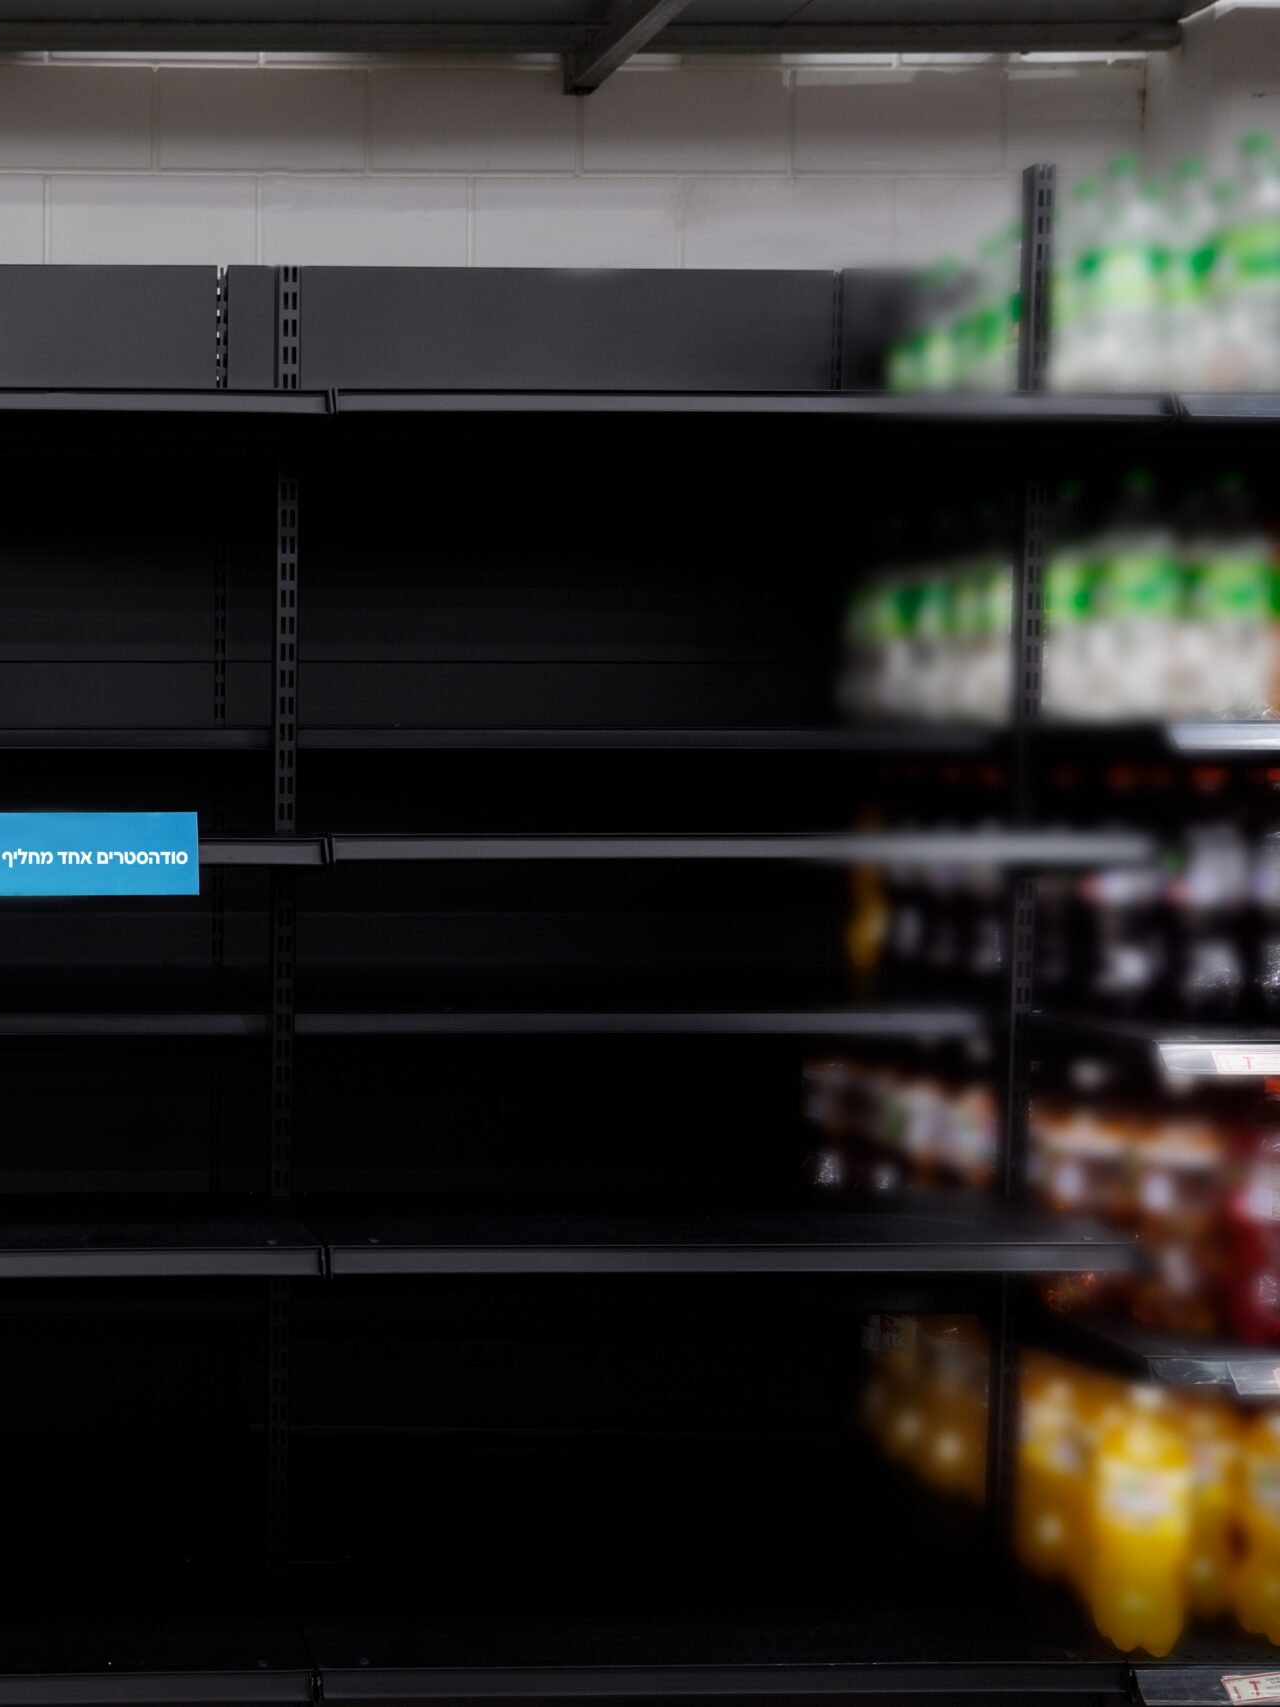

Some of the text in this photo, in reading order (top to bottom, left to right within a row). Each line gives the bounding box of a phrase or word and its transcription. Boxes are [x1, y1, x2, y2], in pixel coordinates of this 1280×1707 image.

[1, 848, 54, 868] מחליף
[56, 851, 93, 865] אחד
[96, 851, 189, 865] סודהסטרים
